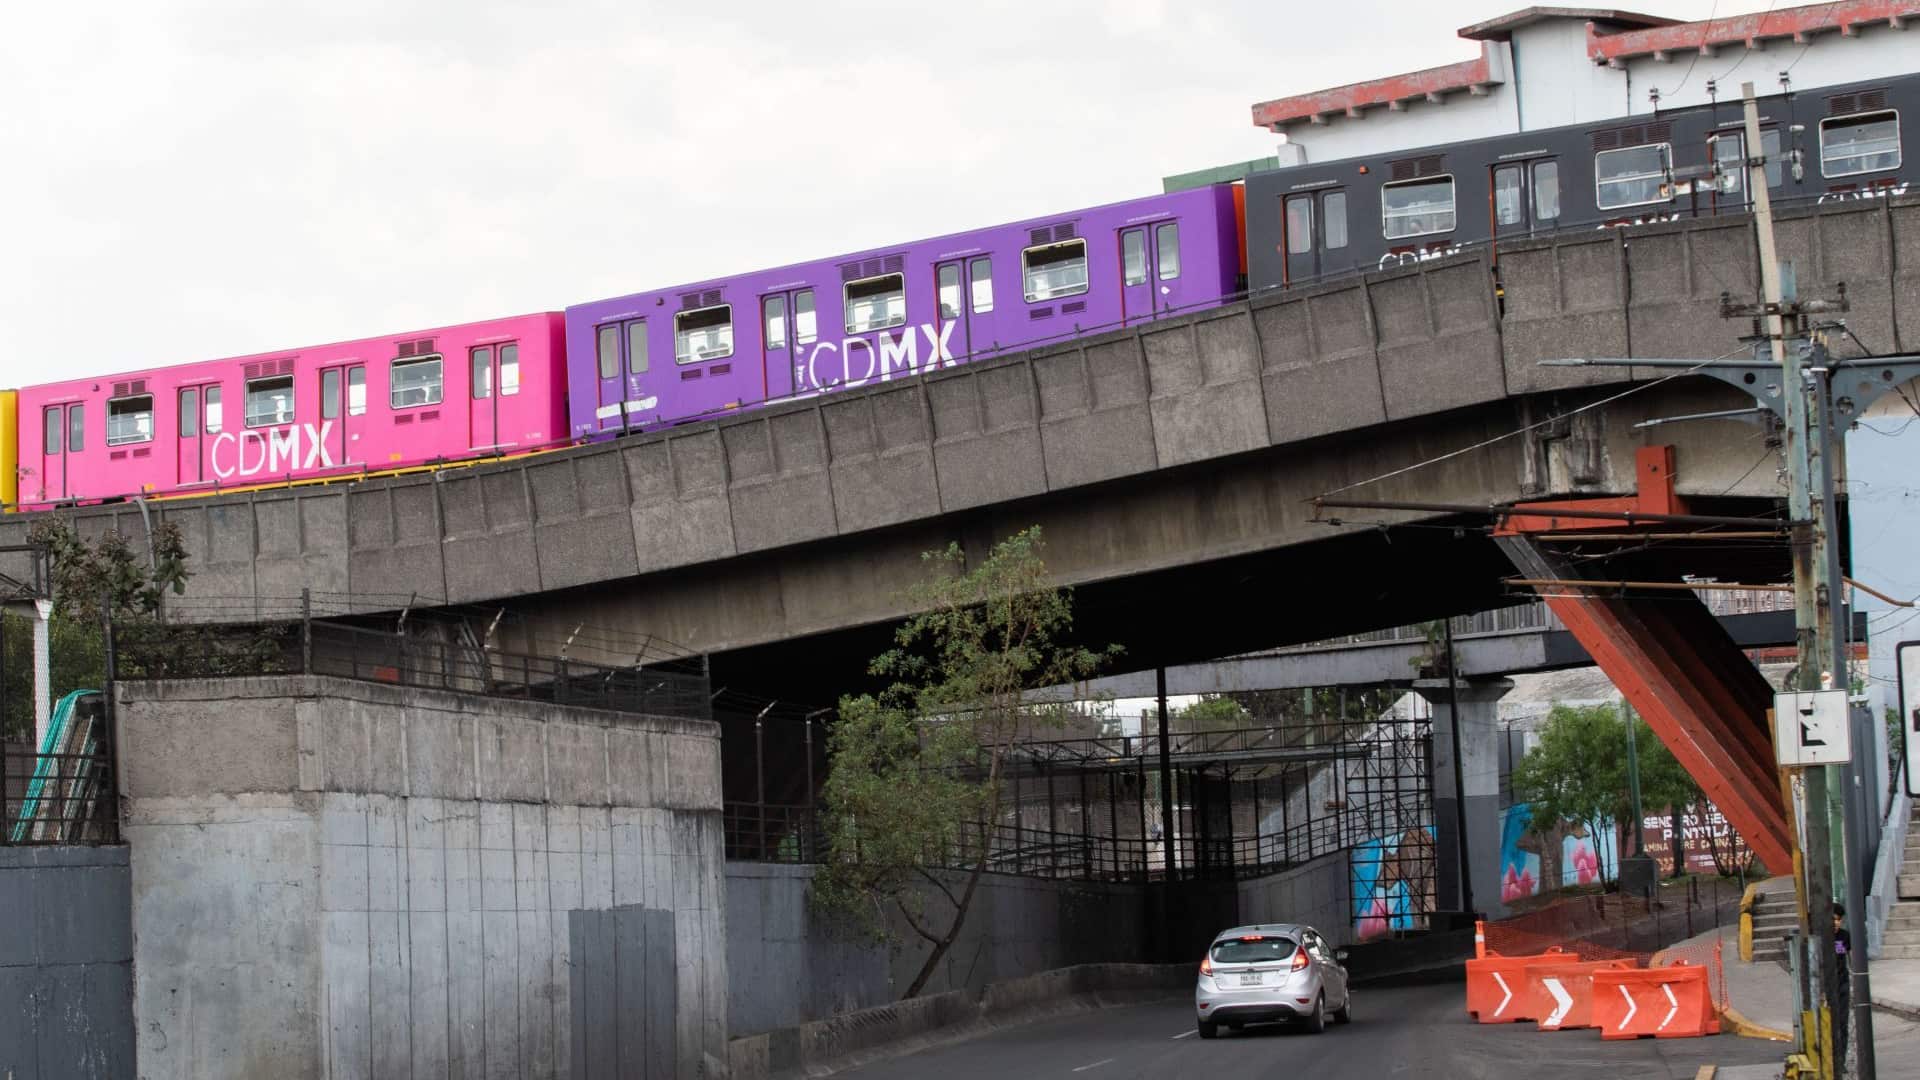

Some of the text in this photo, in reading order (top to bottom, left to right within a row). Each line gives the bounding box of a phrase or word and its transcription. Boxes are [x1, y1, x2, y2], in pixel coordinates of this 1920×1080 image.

[809, 320, 957, 392] CDMX
[212, 421, 334, 478] CDMX
[1643, 815, 1699, 829] SENDRO
[1663, 824, 1735, 841] PNTITLA
